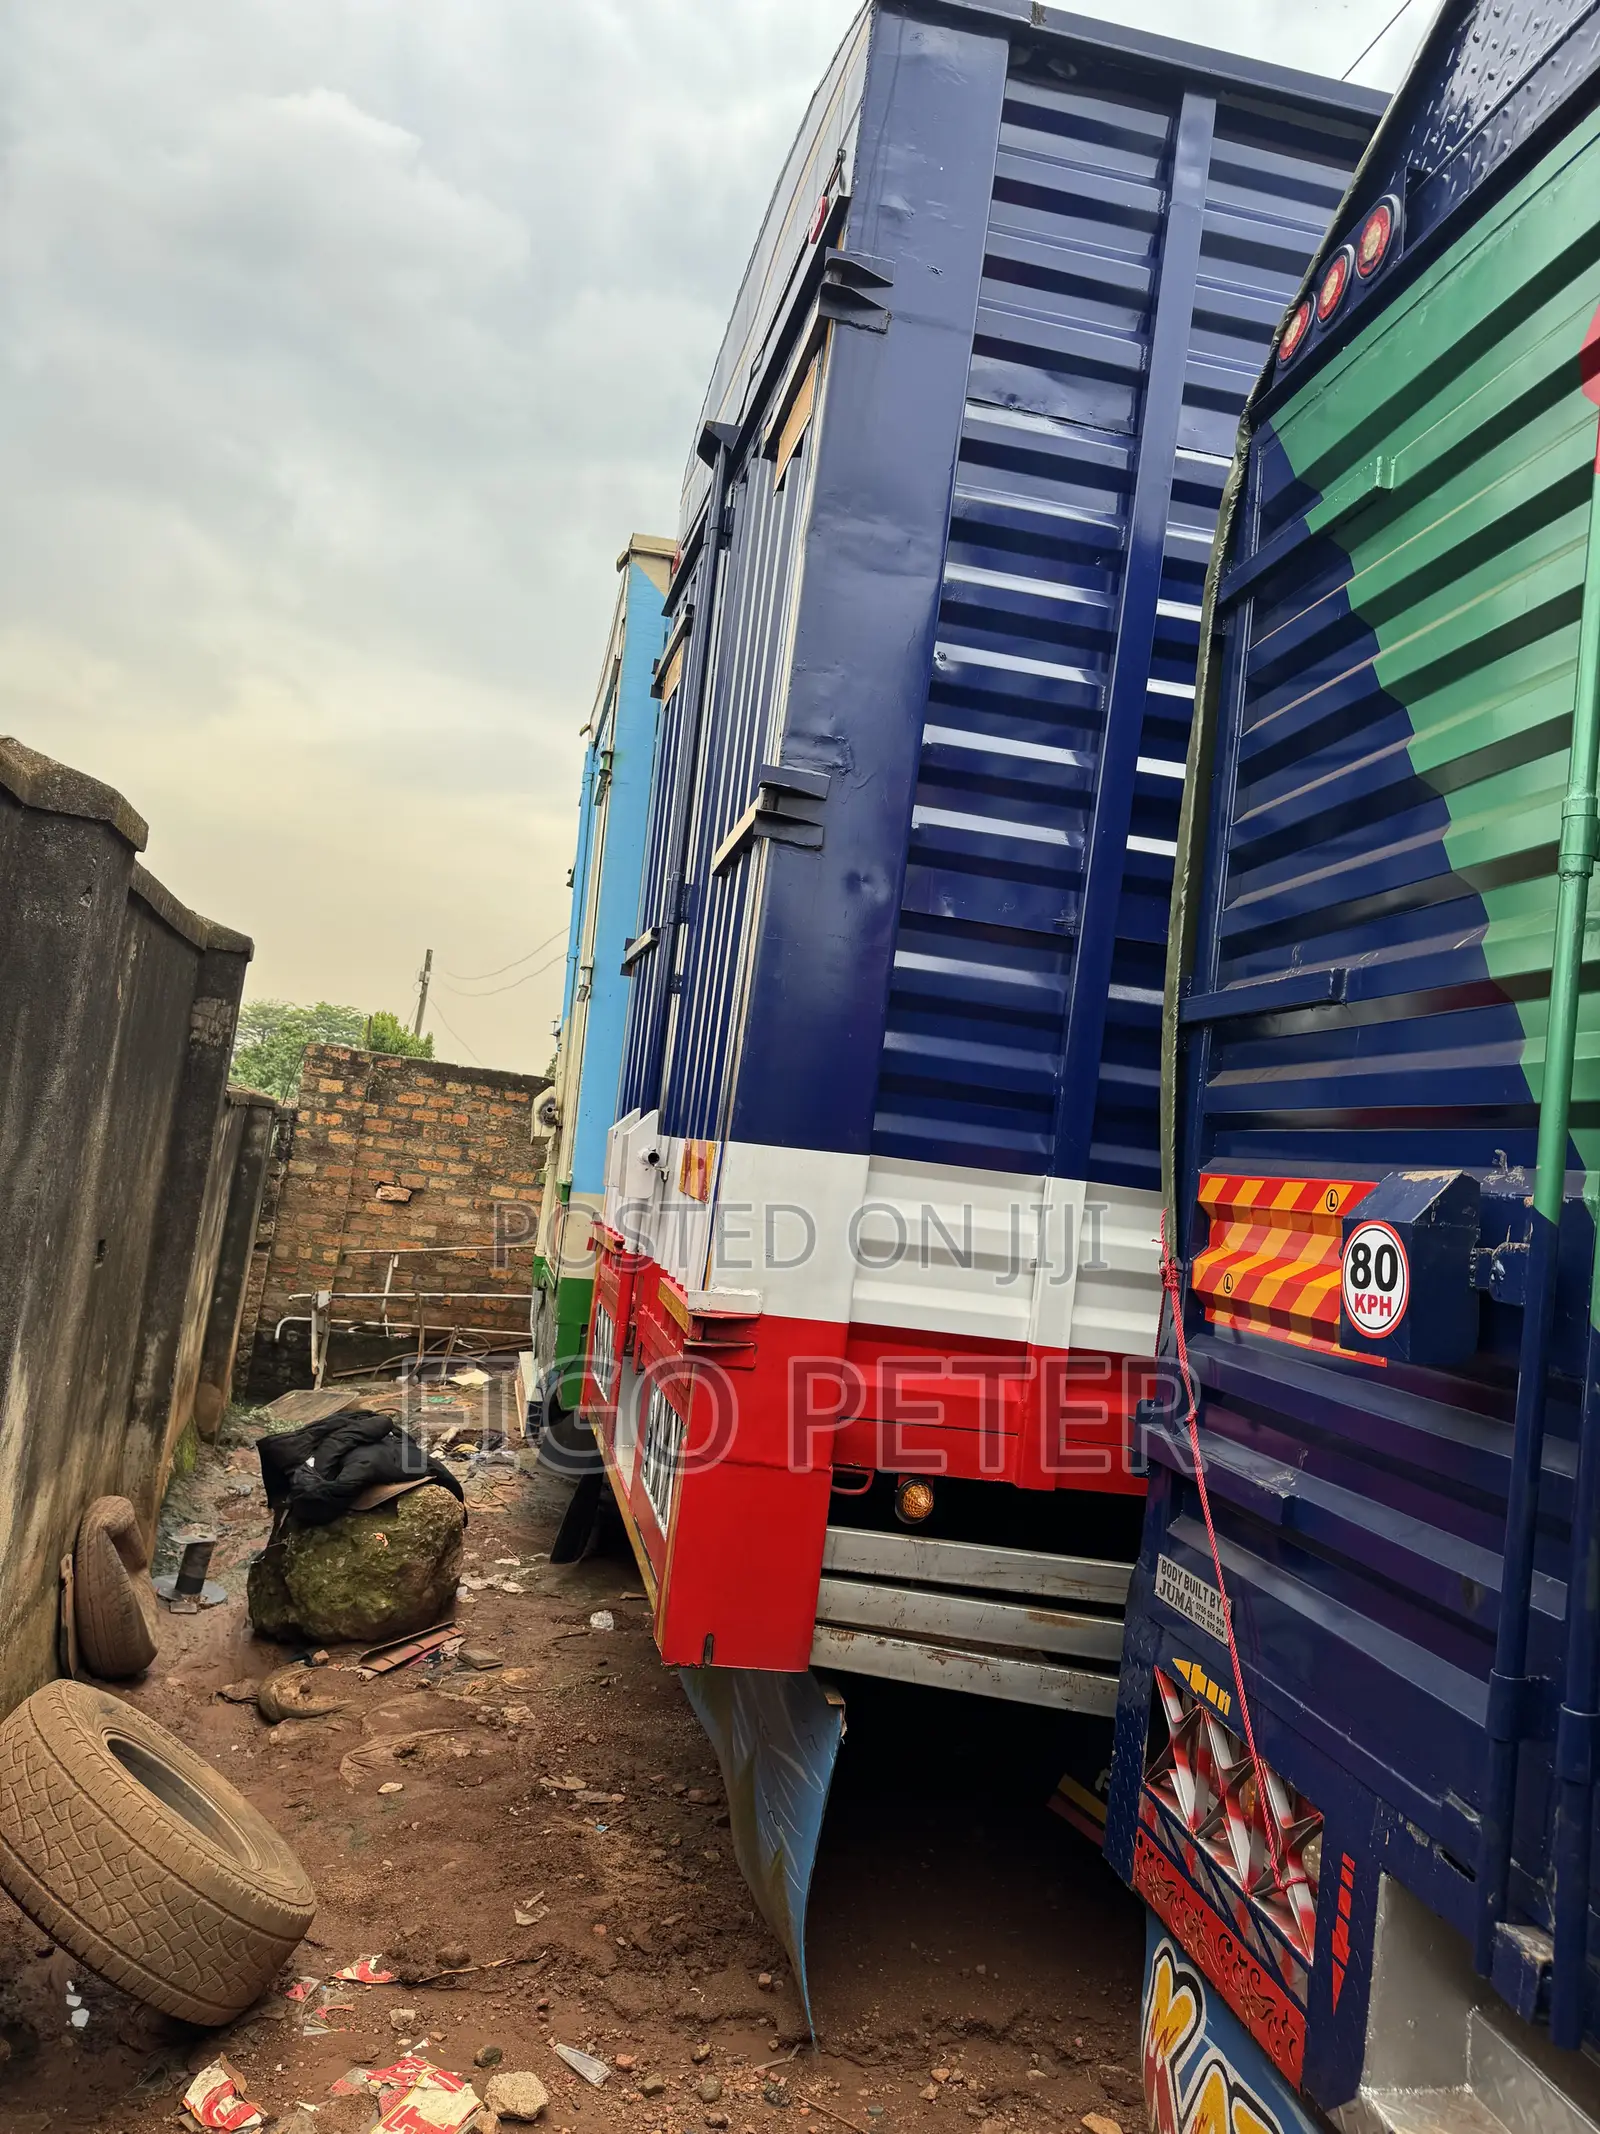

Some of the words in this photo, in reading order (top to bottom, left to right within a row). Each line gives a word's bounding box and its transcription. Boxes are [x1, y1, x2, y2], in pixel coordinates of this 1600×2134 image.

[1350, 1242, 1399, 1292] 80
[1354, 1293, 1392, 1317] KPH
[1159, 1578, 1194, 1617] JUMA
[1161, 1558, 1183, 1586] BODY
[1184, 1574, 1209, 1603] BUILT
[1209, 1591, 1222, 1613] BY
